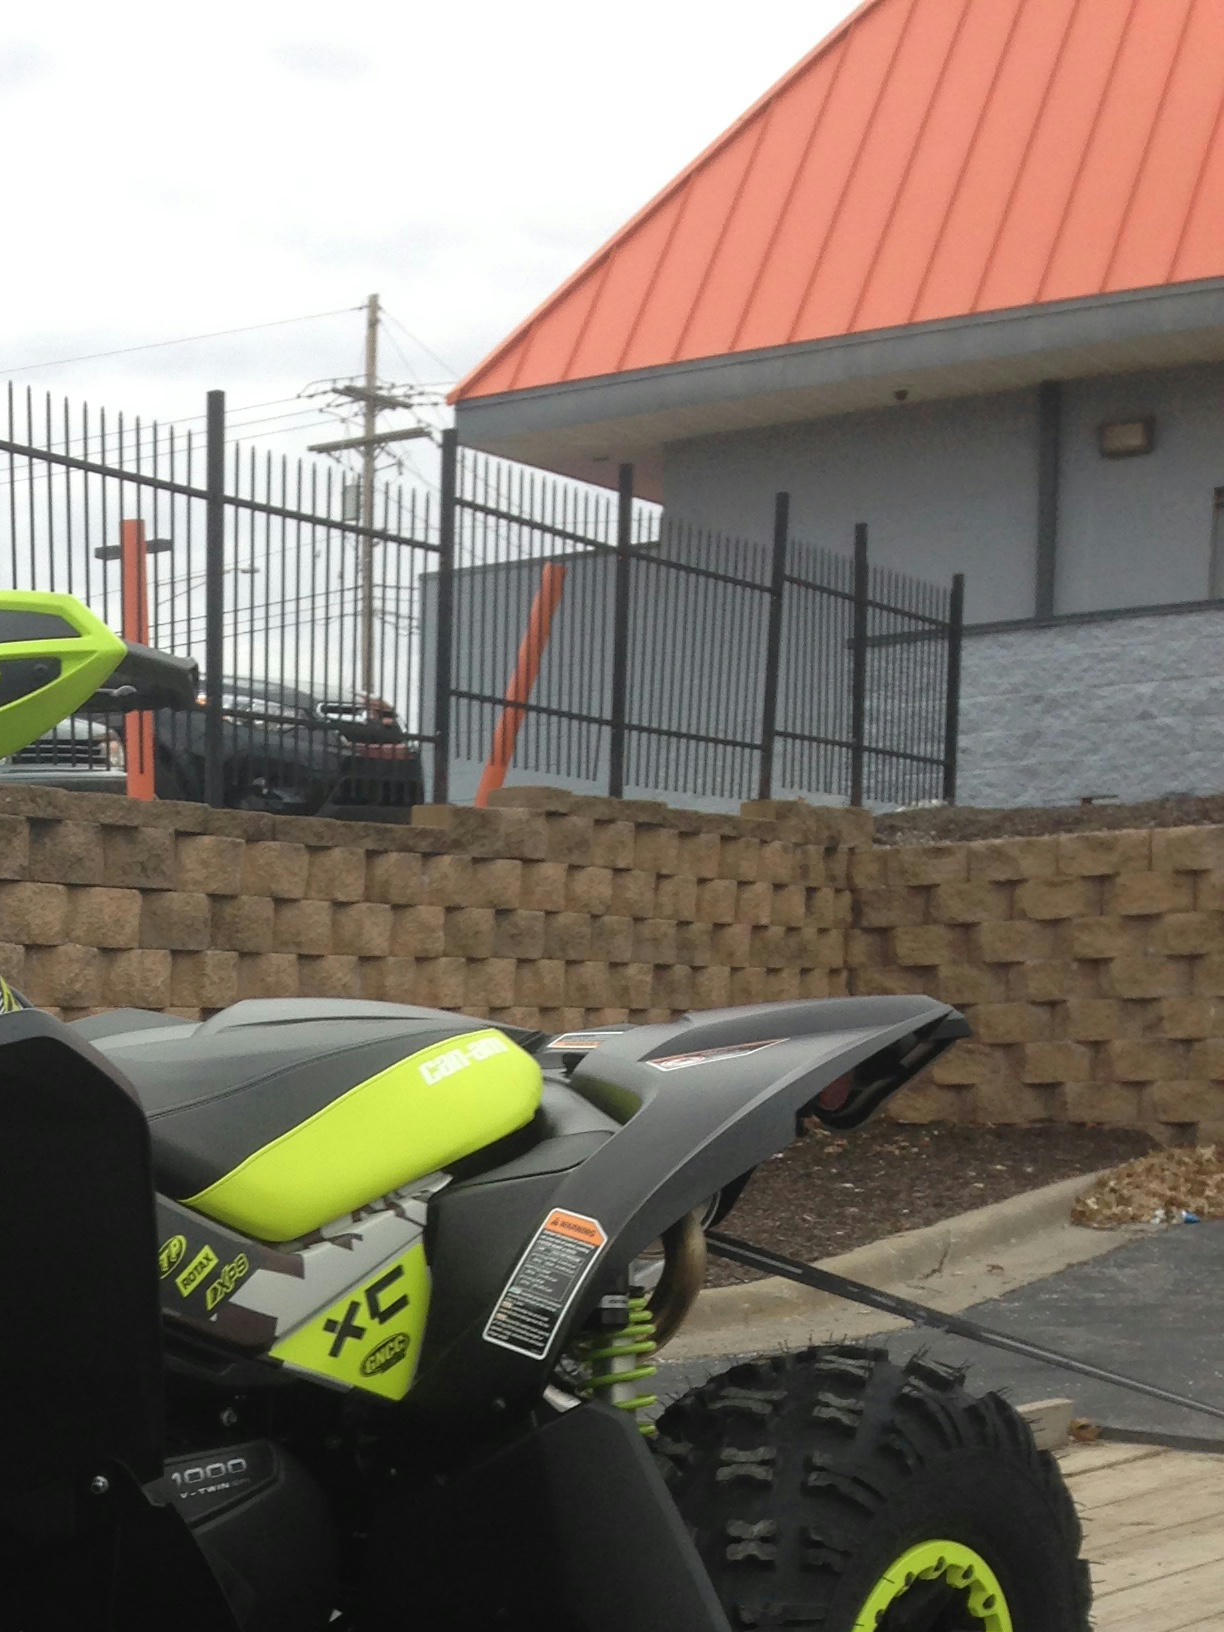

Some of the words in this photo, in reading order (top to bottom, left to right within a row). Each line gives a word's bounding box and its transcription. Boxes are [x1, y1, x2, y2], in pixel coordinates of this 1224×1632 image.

[419, 1036, 509, 1087] can-am
[159, 1238, 181, 1272] TP
[323, 1265, 410, 1358] XC
[171, 1458, 247, 1488] 1000
